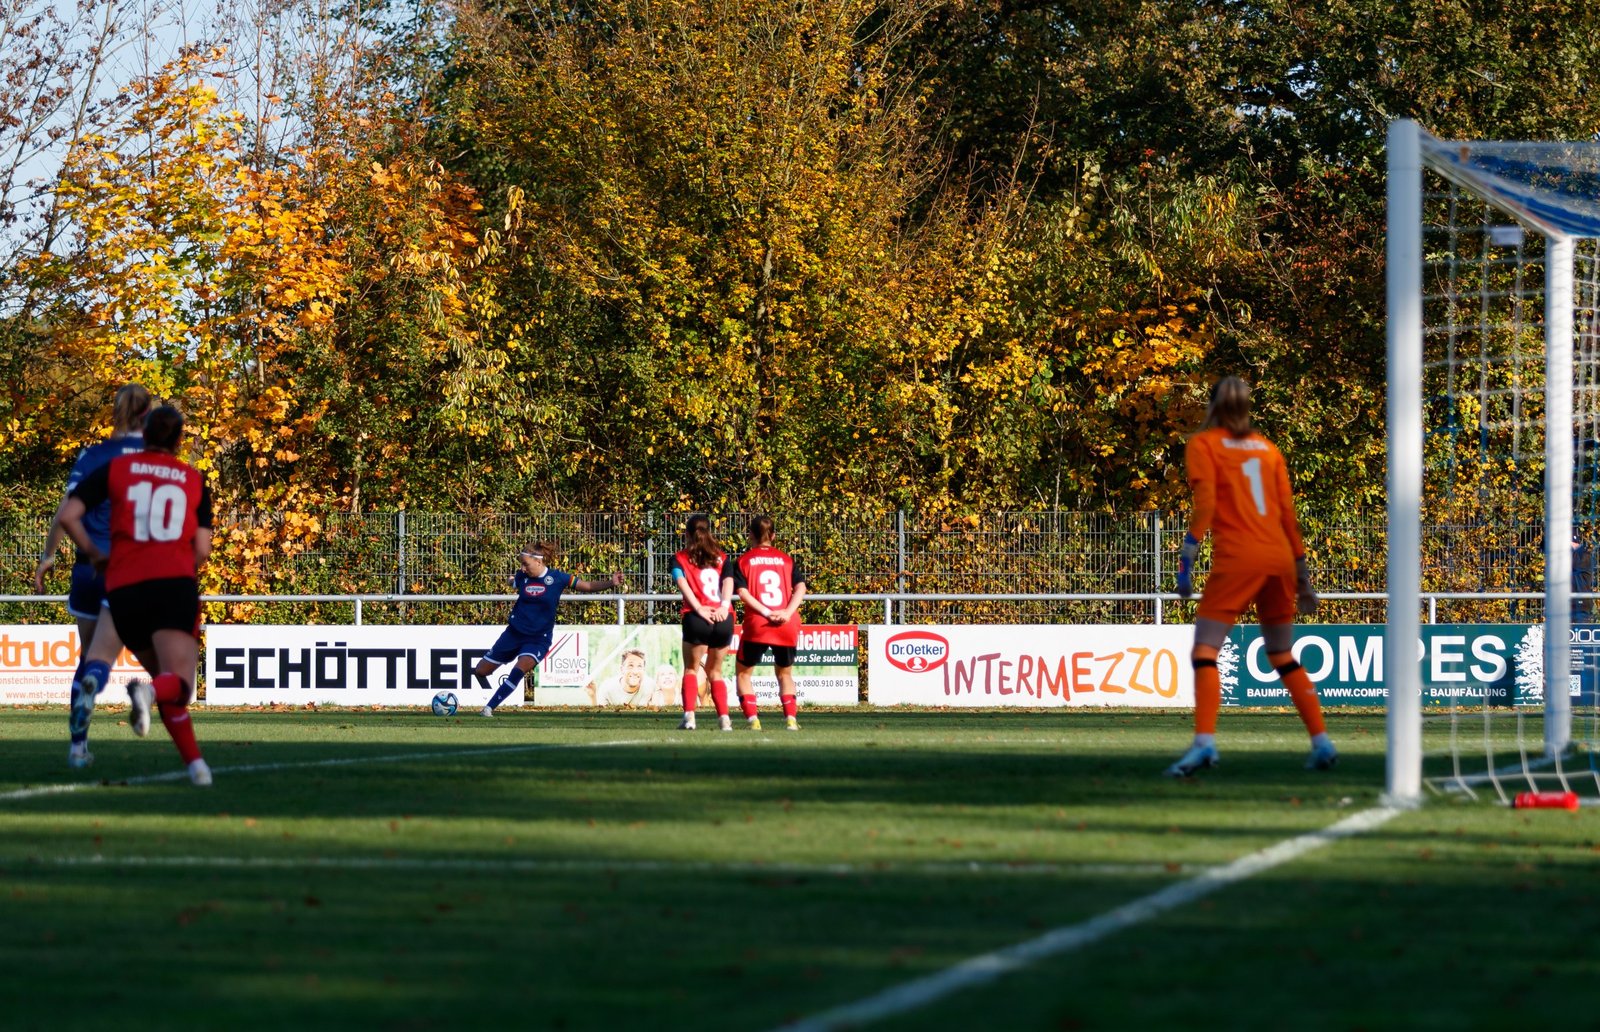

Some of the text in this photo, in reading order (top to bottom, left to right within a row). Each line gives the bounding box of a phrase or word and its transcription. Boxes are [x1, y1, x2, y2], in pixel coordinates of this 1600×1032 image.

[1241, 457, 1267, 517] 1
[127, 481, 187, 542] 10
[700, 567, 721, 602] 8
[759, 569, 783, 607] 3
[797, 631, 854, 651] ücklich!
[808, 653, 821, 663] Sie
[823, 653, 854, 663] suchen!
[215, 642, 492, 689] SCHÖTTLER
[554, 658, 587, 669] GSWG
[943, 647, 1178, 701] INTERMEZZO
[835, 680, 844, 688] 80
[845, 680, 854, 688] 91
[1431, 686, 1507, 697] BAUMFÄLLUNG
